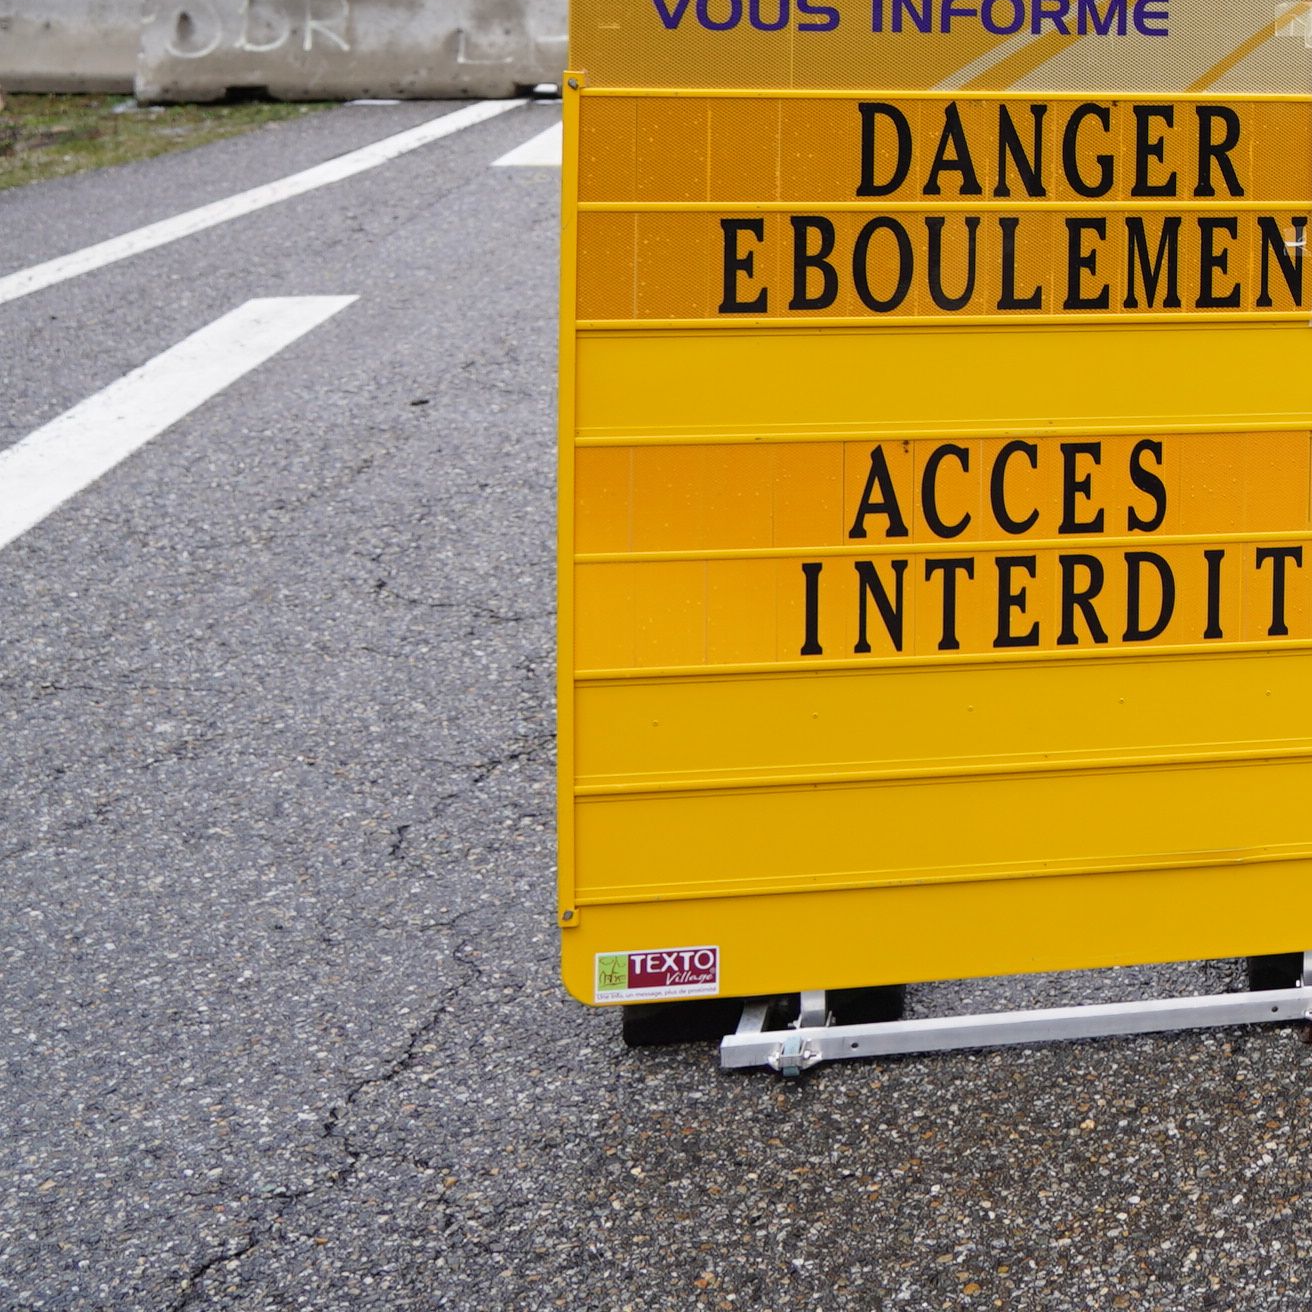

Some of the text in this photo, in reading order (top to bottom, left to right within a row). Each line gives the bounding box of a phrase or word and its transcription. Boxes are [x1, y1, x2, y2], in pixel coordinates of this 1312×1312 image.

[856, 101, 1245, 198] DANGER
[848, 439, 1167, 539] ACCES
[800, 546, 1303, 656] INTERDIT
[630, 949, 715, 975] TEXTO
[665, 971, 713, 985] Village
